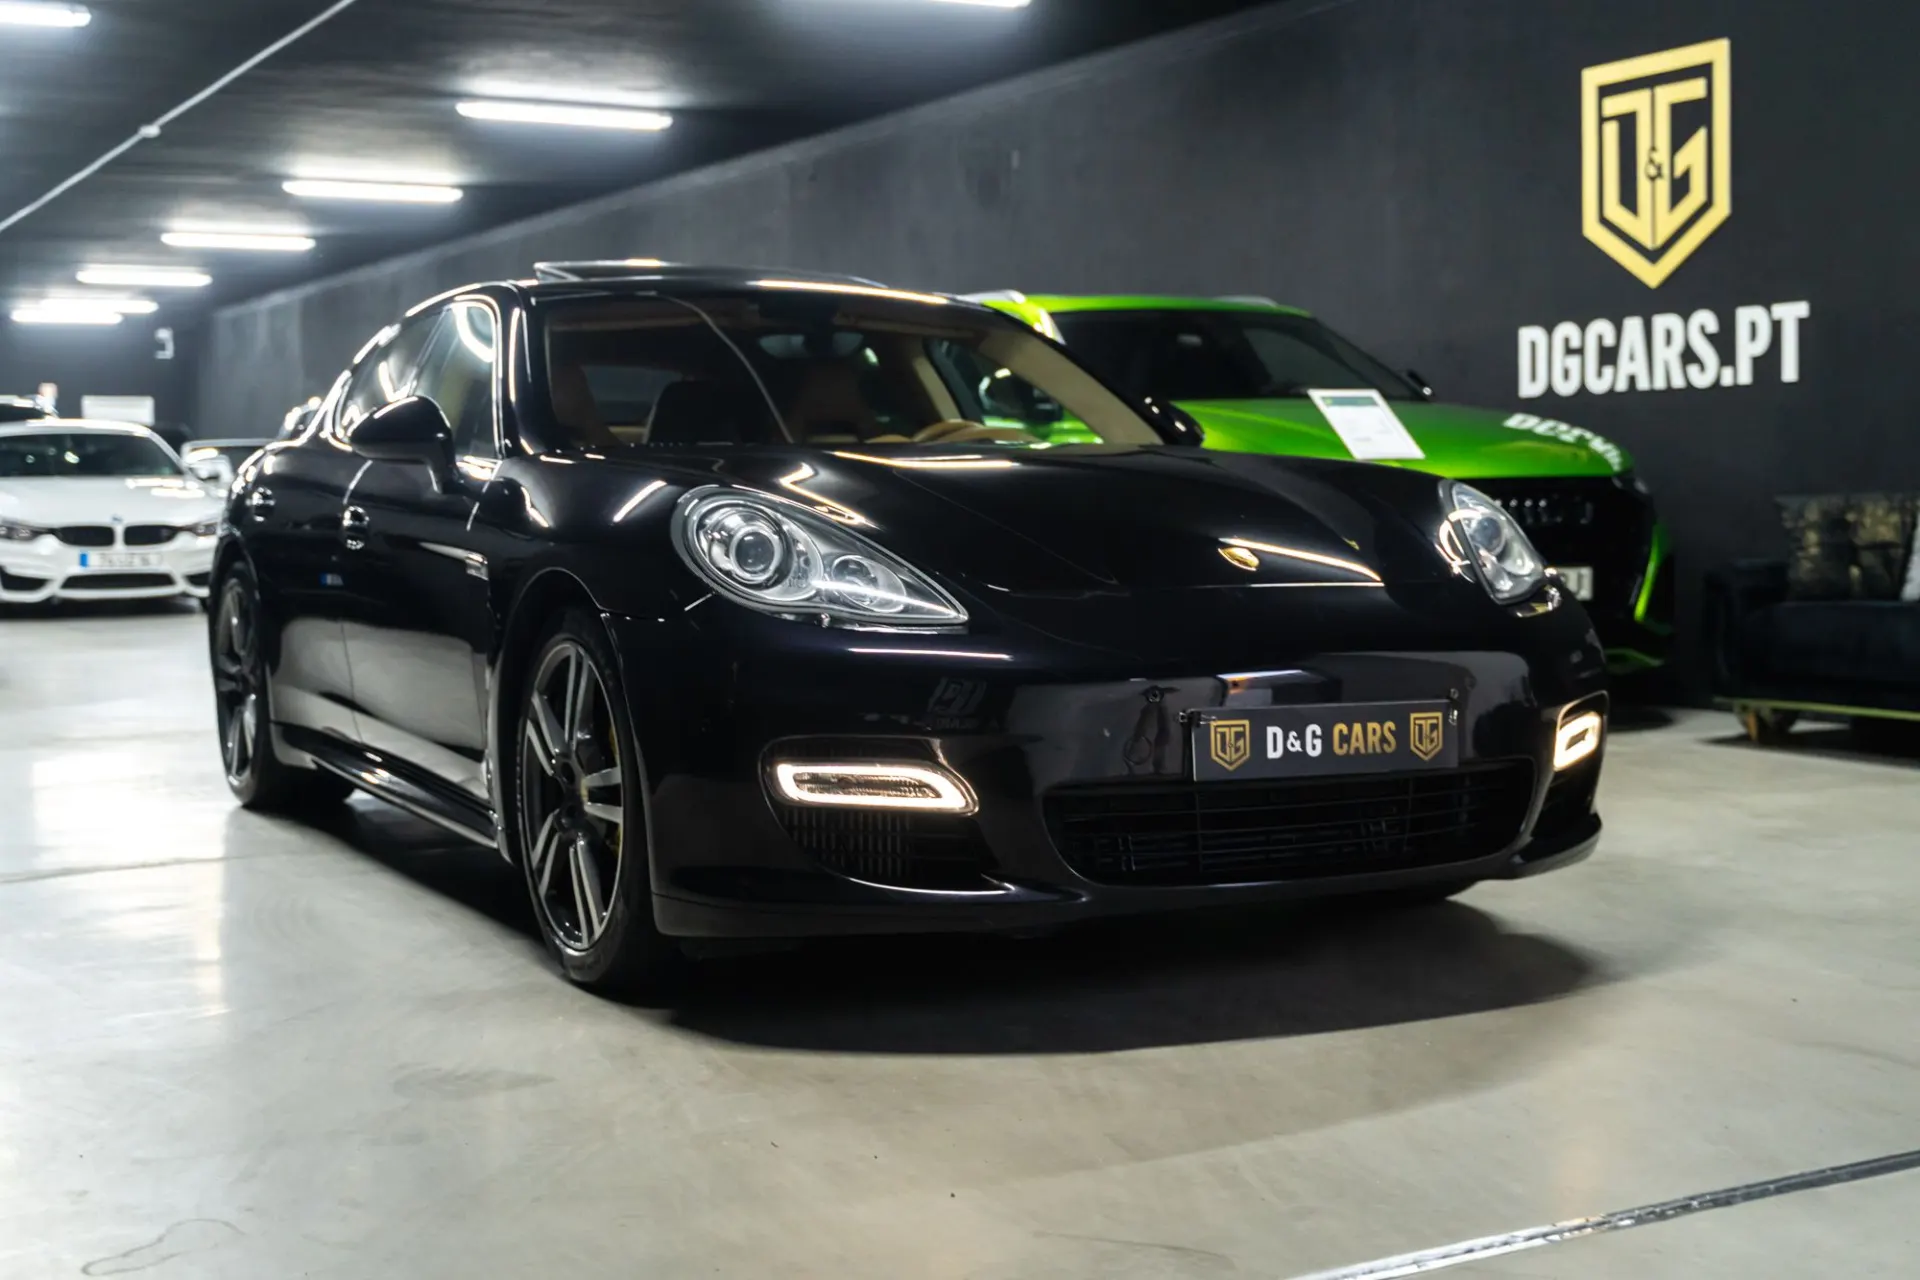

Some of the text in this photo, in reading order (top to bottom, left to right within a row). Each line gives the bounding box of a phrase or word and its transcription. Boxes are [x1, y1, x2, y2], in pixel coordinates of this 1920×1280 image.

[1517, 301, 1810, 399] DGCARS.PT
[1266, 721, 1397, 759] D&G CARS
